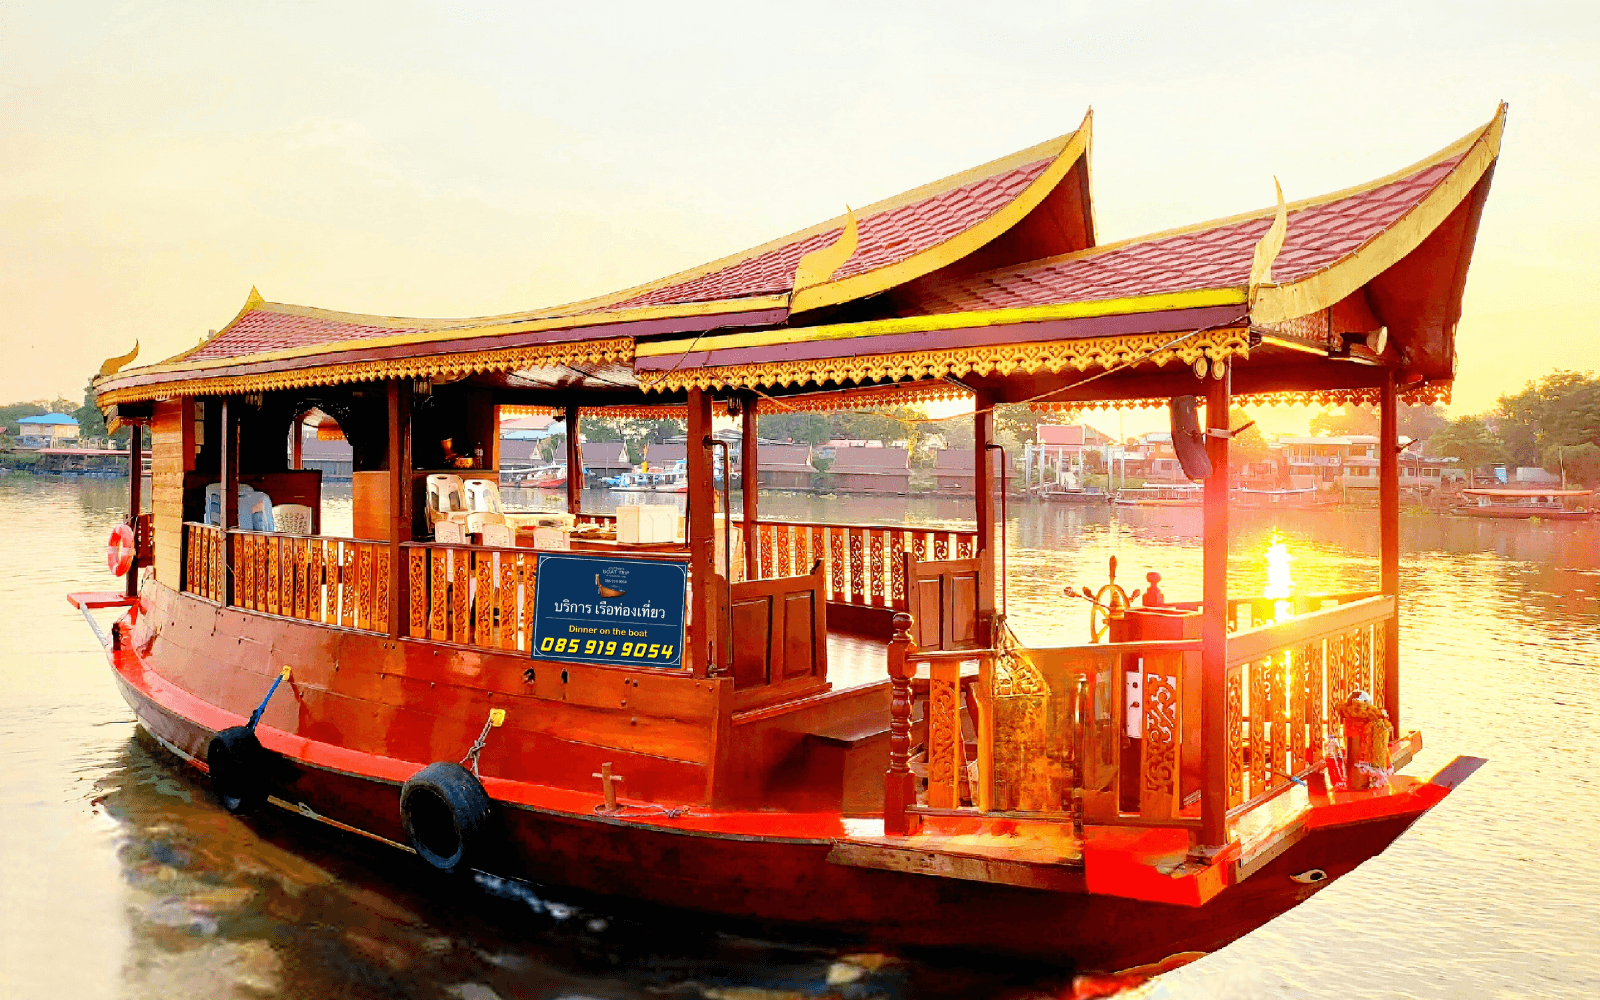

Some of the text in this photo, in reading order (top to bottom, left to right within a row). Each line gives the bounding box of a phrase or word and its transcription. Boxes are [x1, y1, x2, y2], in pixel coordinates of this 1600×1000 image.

[554, 599, 666, 619] บริการ เรือท่องเที่ยว
[569, 625, 598, 634] Dinner
[612, 627, 627, 636] the
[628, 628, 648, 637] boat
[540, 637, 674, 659] 085 919 9054
